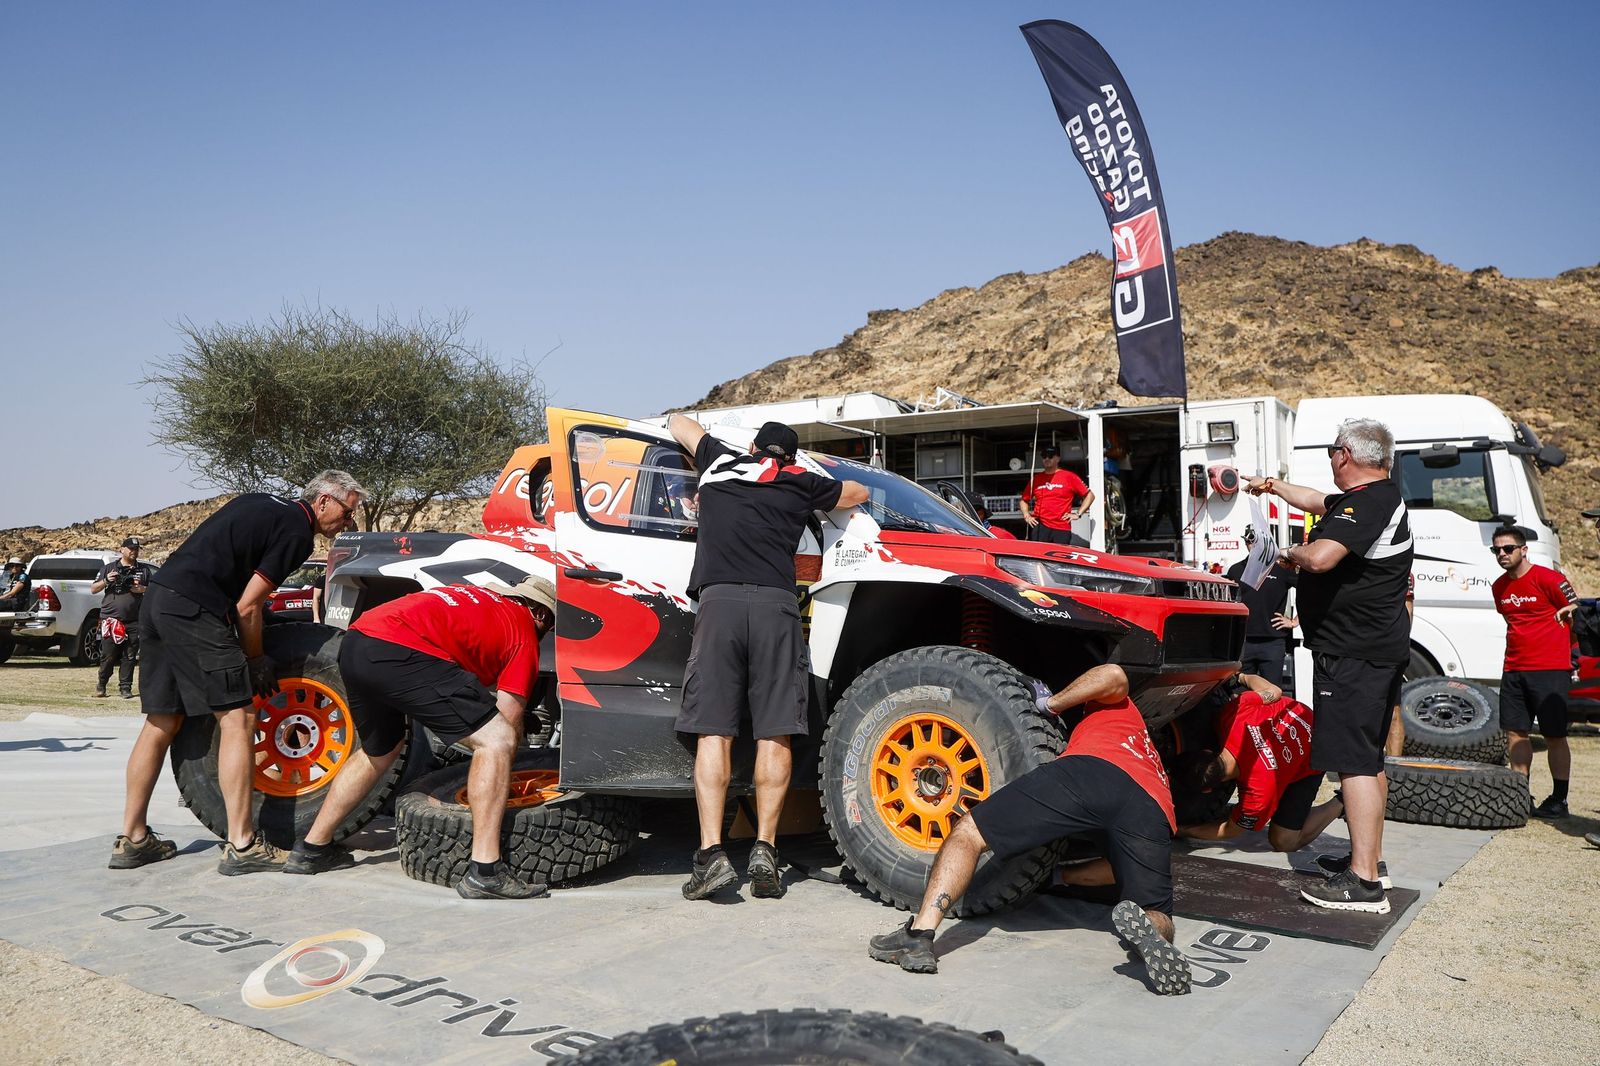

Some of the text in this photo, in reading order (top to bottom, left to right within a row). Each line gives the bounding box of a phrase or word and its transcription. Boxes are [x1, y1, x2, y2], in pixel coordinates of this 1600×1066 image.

[1212, 526, 1231, 534] NGK
[1208, 541, 1238, 549] MOTUL
[842, 550, 868, 558] LATEGAN
[1044, 551, 1099, 564] GR
[1416, 573, 1450, 583] over
[1186, 580, 1232, 602] TOYOTA
[1033, 606, 1072, 620] repsol
[100, 904, 613, 1060] over drive
